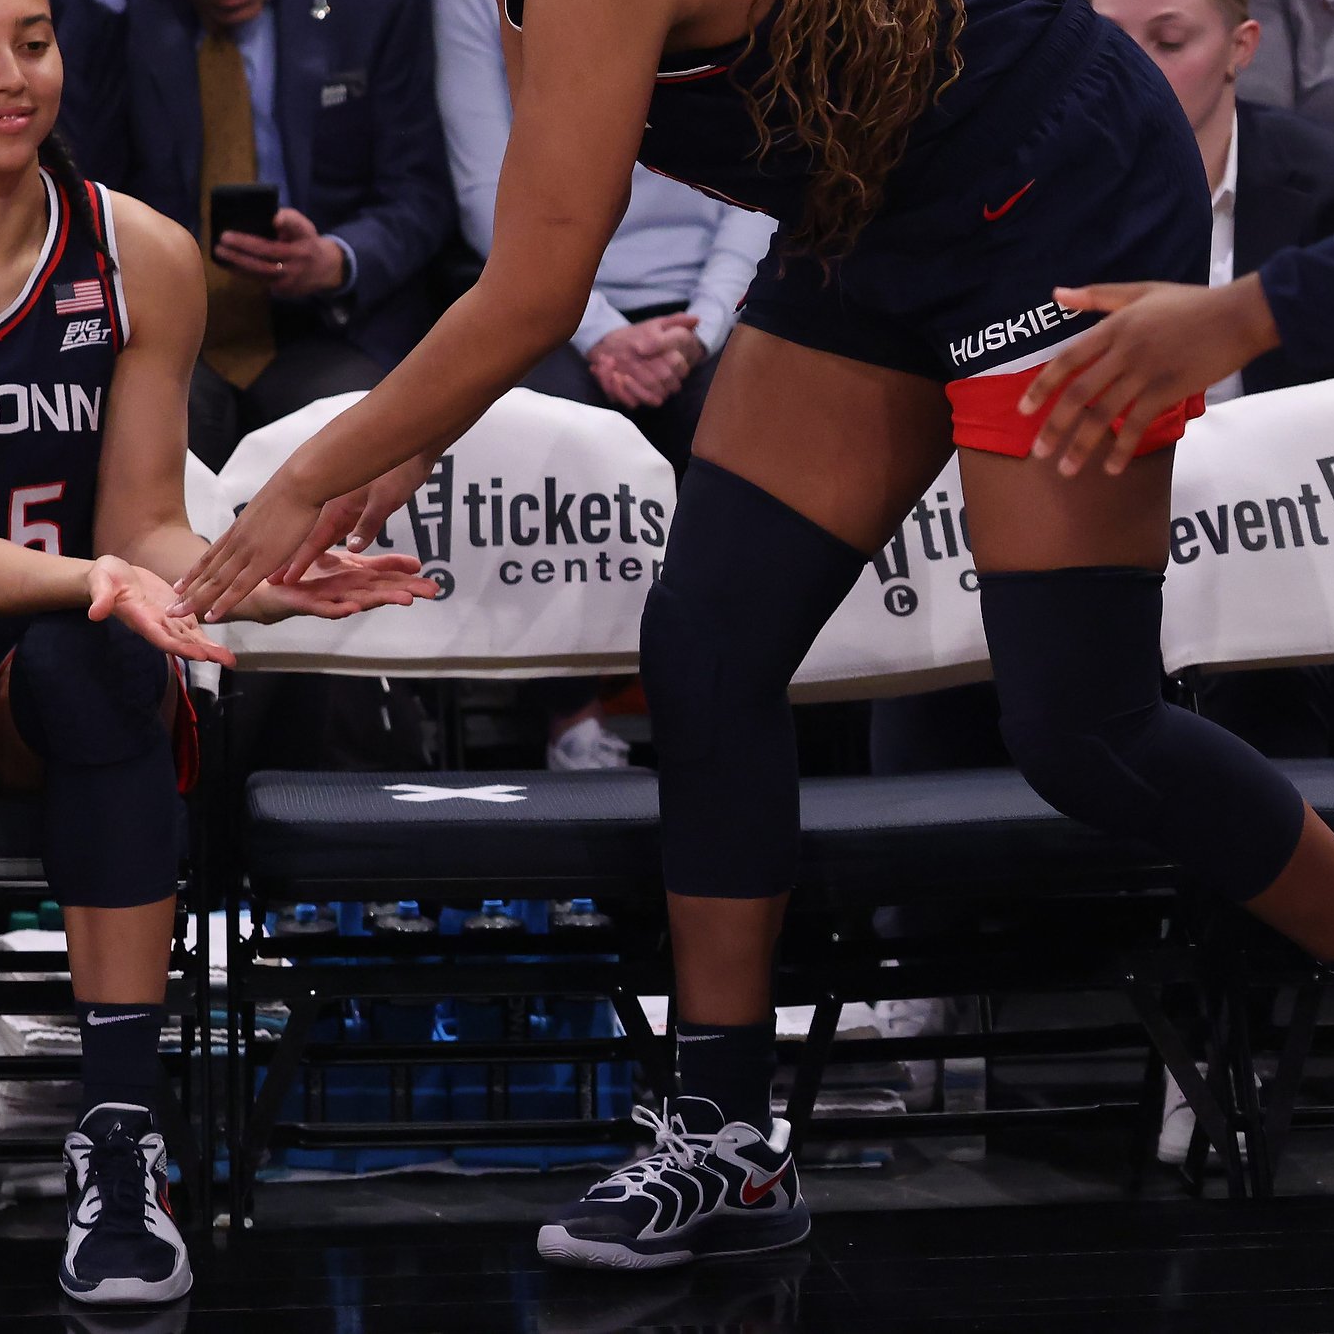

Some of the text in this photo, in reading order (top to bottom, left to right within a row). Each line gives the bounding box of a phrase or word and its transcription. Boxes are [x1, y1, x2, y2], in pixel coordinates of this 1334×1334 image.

[62, 328, 111, 345] EAST
[67, 318, 101, 333] BIG
[463, 477, 665, 547] tickets
[1170, 484, 1329, 565] event
